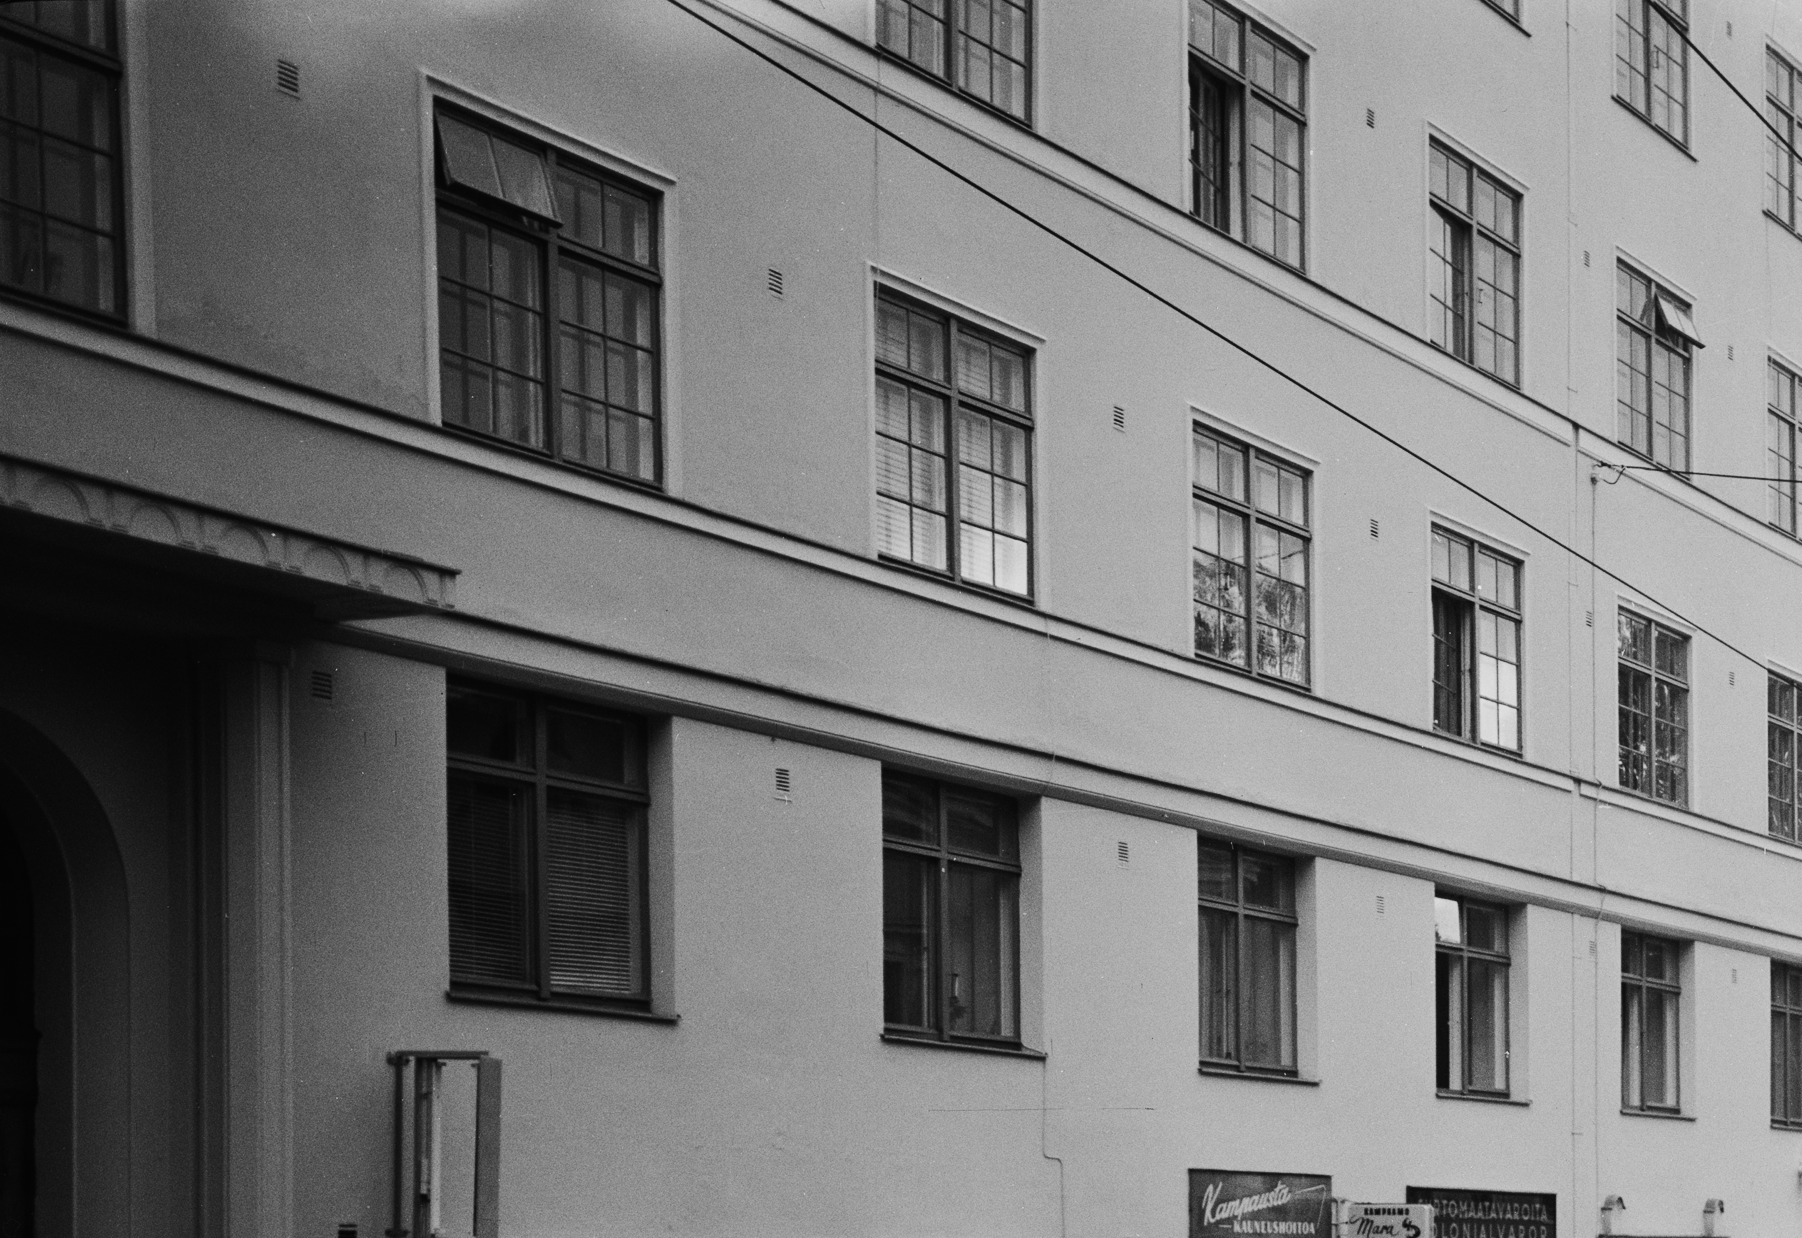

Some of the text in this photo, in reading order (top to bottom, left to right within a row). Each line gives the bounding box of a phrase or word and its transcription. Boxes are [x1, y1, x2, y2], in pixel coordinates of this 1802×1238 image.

[1201, 1180, 1292, 1226] Kampausta
[1364, 1207, 1410, 1216] KAMPAAMO
[1418, 1198, 1549, 1221] RTOMAATAVAROITA
